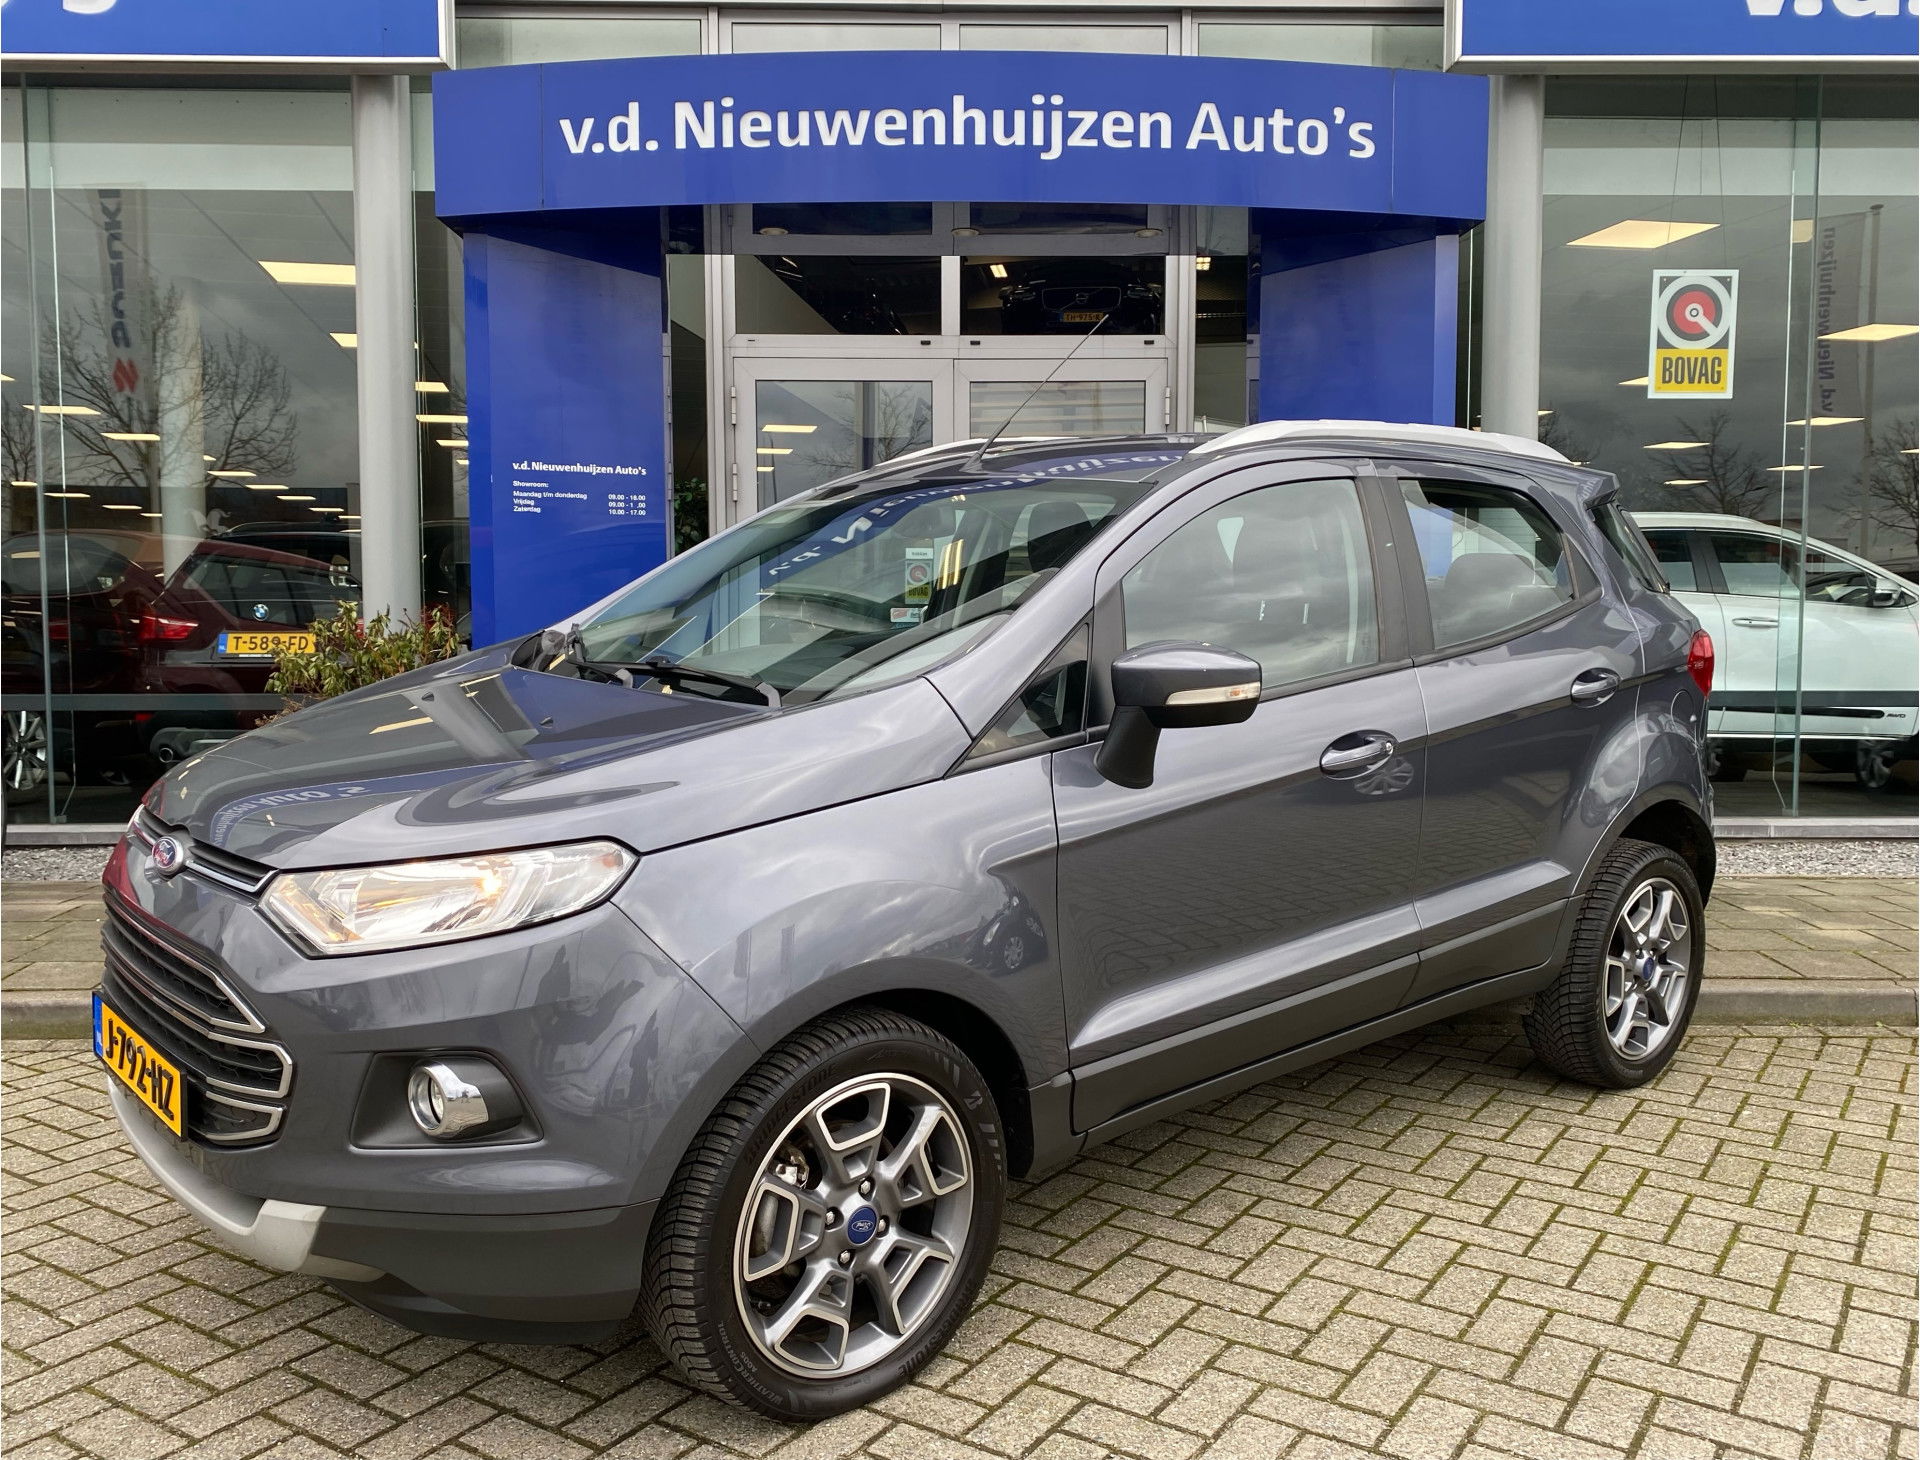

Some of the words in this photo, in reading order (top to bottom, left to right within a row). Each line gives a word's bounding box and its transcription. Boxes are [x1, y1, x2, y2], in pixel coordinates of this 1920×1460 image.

[559, 101, 659, 154] v.d.
[674, 94, 1172, 160] Nieuwenhuijzen
[1185, 102, 1377, 159] Auto's
[1661, 356, 1722, 385] BOVAG
[512, 461, 530, 470] v.d.
[532, 461, 613, 475] Nieuwenhuijzen
[615, 465, 647, 475] Auto's
[512, 480, 549, 488] Showroom:
[512, 490, 542, 498] Maandag
[554, 492, 588, 500] donderdag
[513, 498, 535, 506] Vrijdag
[513, 505, 541, 513] Zaterdag
[106, 1018, 175, 1121] J-792-HZ
